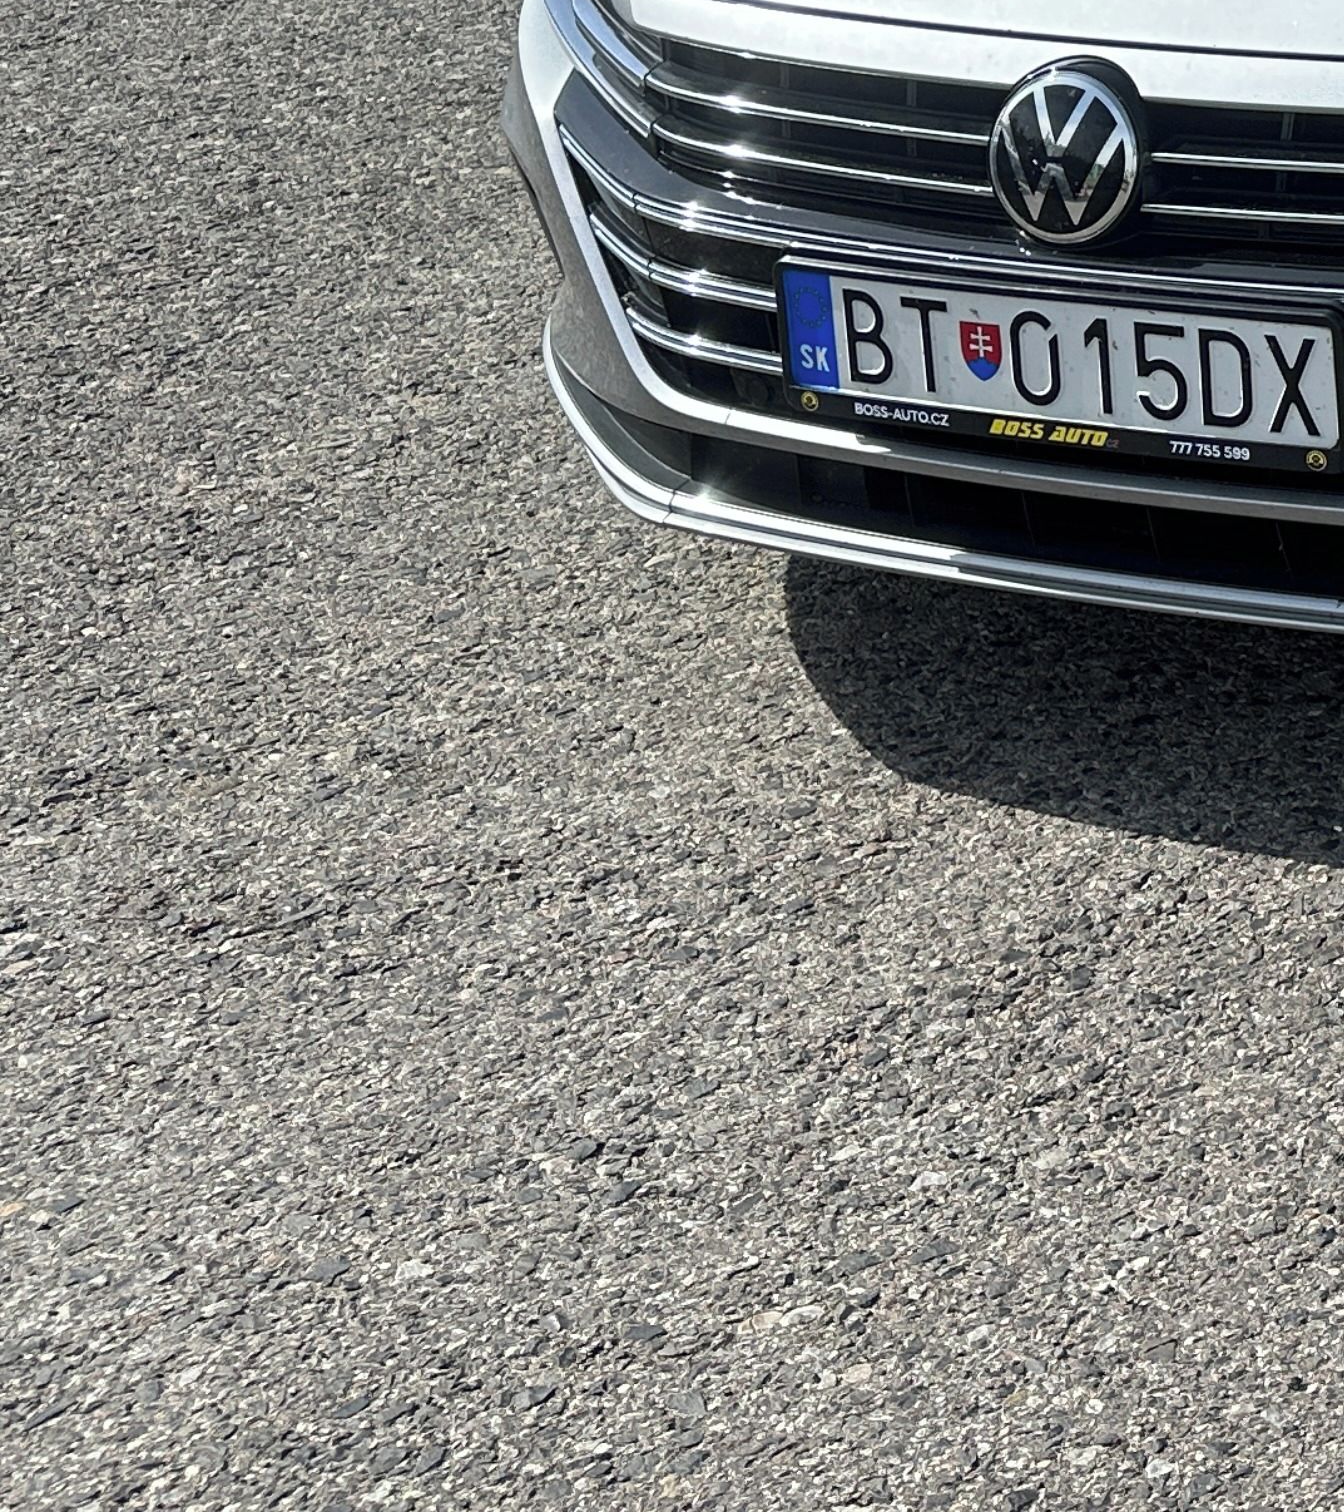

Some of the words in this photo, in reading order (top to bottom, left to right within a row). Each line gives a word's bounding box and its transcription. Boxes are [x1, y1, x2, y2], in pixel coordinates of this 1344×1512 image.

[800, 343, 831, 373] SK
[841, 288, 948, 394] BT
[1009, 310, 1322, 438] 015DX
[854, 402, 950, 428] BOSS-AUTO.CZ
[988, 417, 1045, 440] BOSS
[1048, 425, 1109, 447] AUTO
[1170, 440, 1195, 456] 777
[1196, 443, 1221, 458] 755
[1224, 445, 1250, 461] 599
